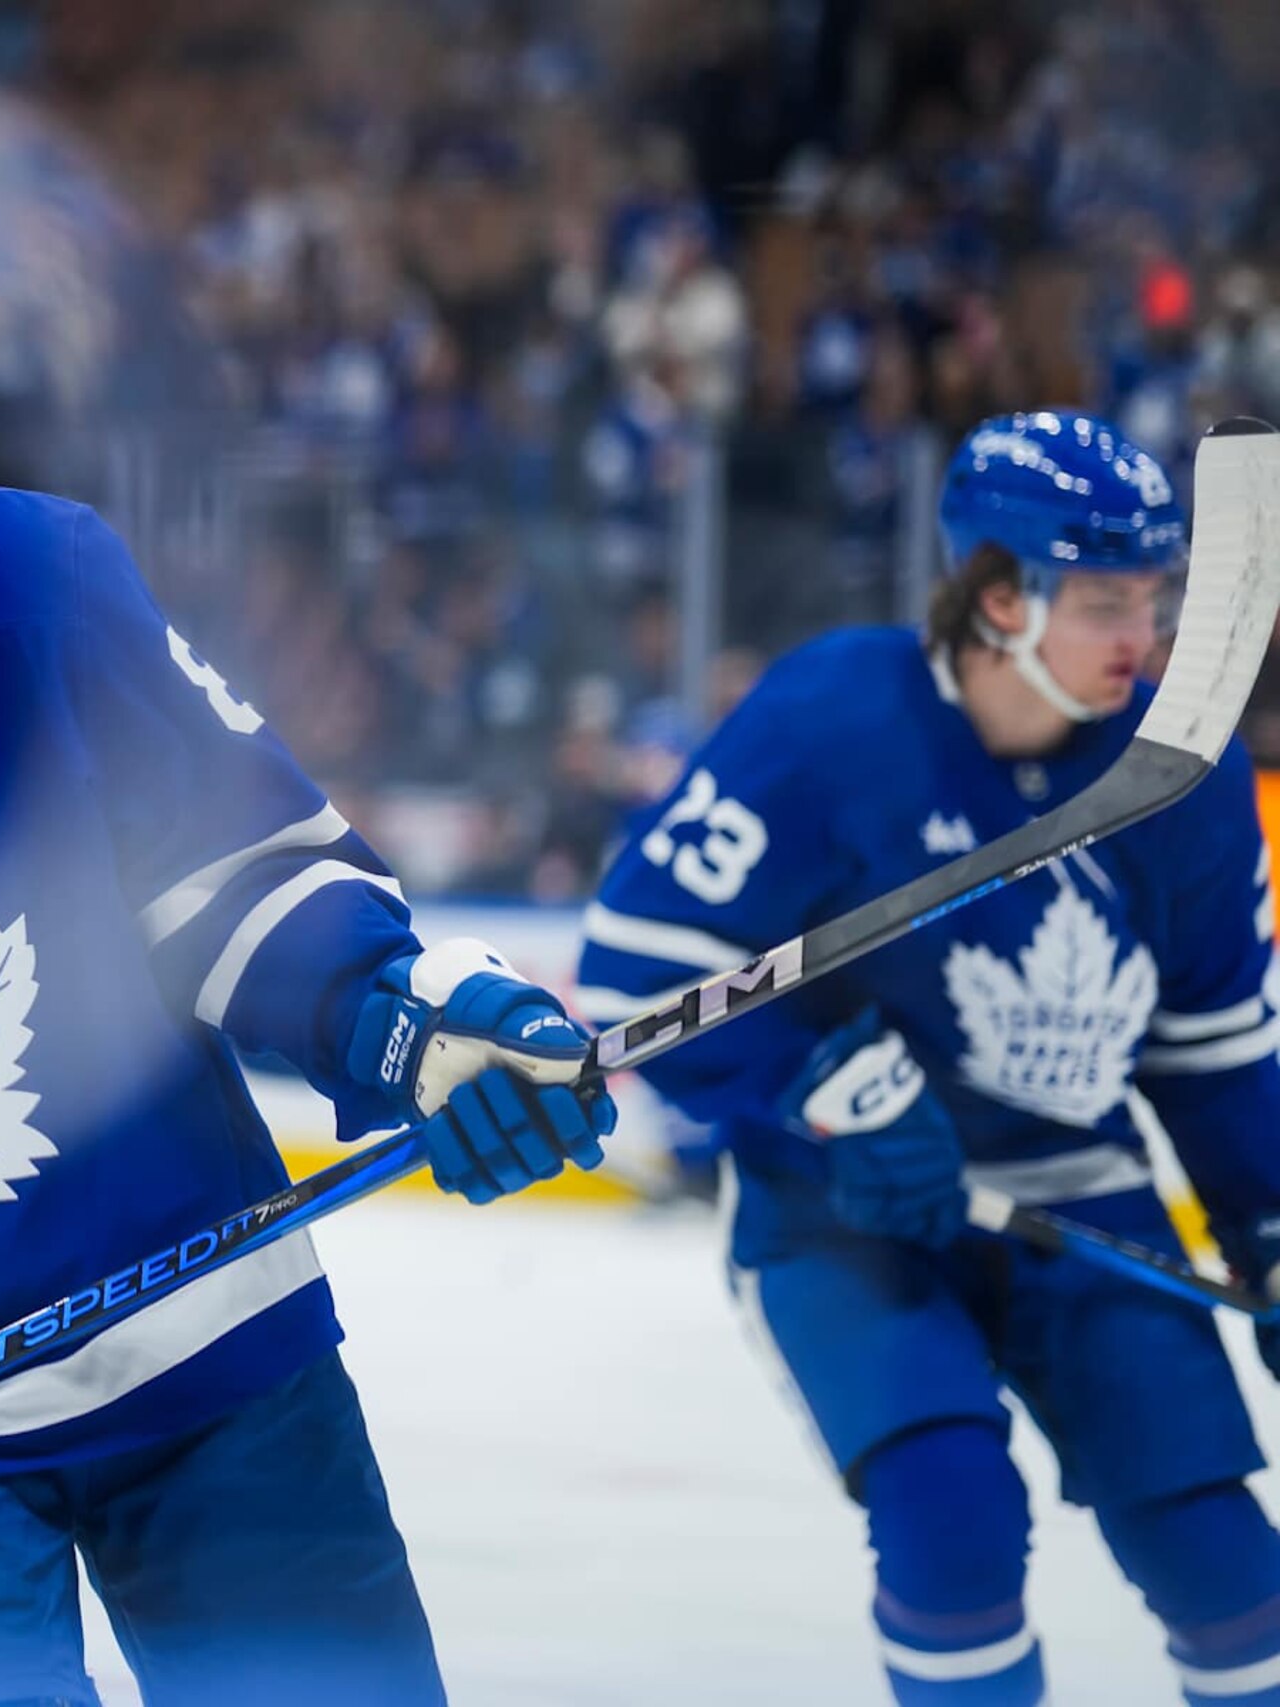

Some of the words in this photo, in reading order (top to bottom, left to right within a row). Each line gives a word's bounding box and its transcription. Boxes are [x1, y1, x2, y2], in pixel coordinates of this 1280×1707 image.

[641, 765, 769, 906] 23
[380, 1010, 410, 1083] CCM
[521, 1016, 576, 1039] CC
[596, 935, 803, 1068] CM
